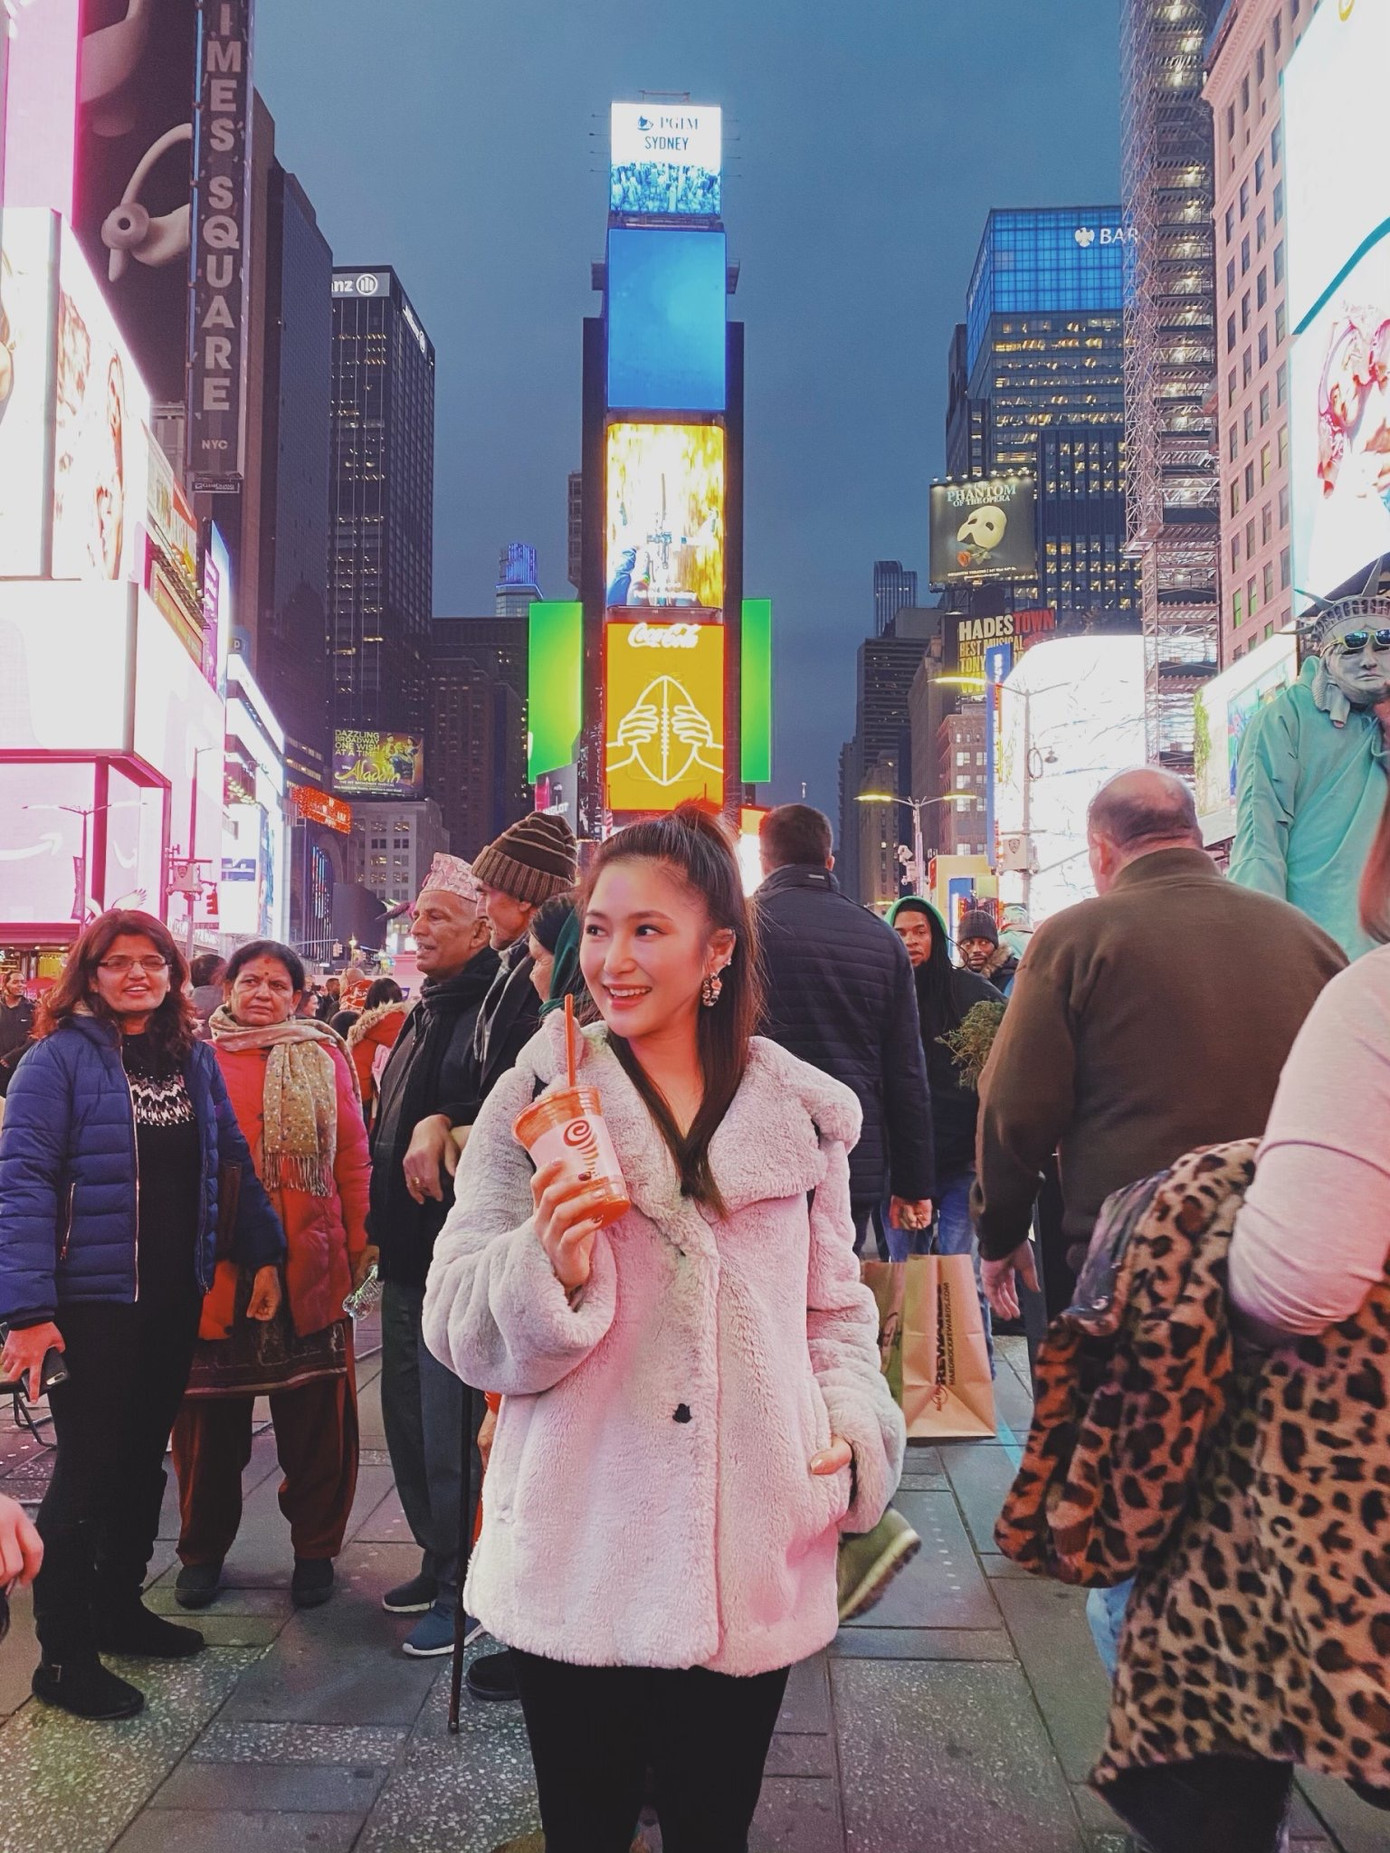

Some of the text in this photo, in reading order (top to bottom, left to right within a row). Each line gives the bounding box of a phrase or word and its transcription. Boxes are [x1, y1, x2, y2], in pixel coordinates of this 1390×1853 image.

[660, 117, 698, 130] PGIM
[644, 136, 689, 151] SYDNEY
[202, 176, 240, 411] SQUARE
[201, 439, 228, 450] NYC
[946, 484, 1017, 502] PHANTOM
[959, 640, 983, 658] BEST
[334, 729, 380, 741] DAZZLING
[334, 736, 380, 745] BROADWAY
[334, 743, 380, 751] ONE WISH
[334, 748, 347, 756] AT
